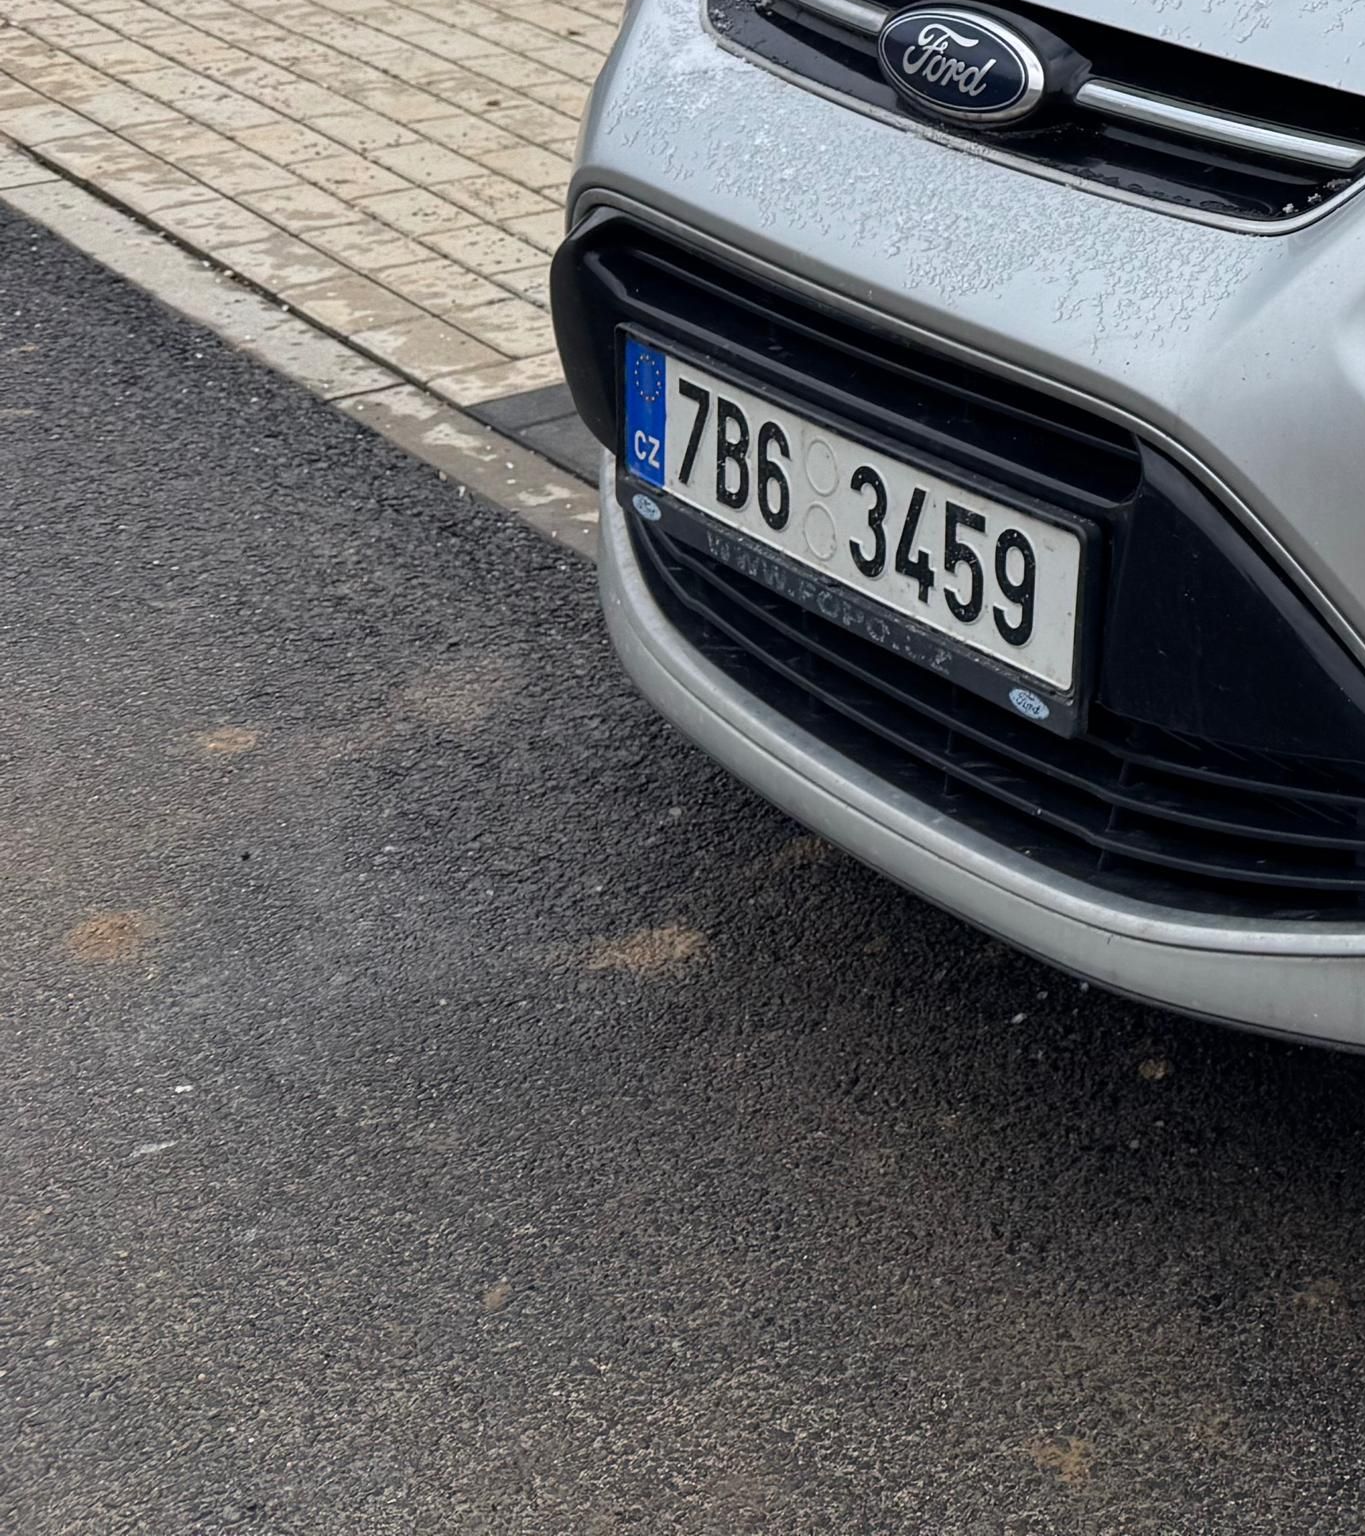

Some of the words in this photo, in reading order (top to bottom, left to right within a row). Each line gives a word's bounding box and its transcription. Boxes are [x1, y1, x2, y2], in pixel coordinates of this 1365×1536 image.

[902, 23, 997, 97] Ford
[634, 429, 660, 469] CZ
[678, 377, 793, 531] 7B6
[848, 465, 1037, 647] 3459
